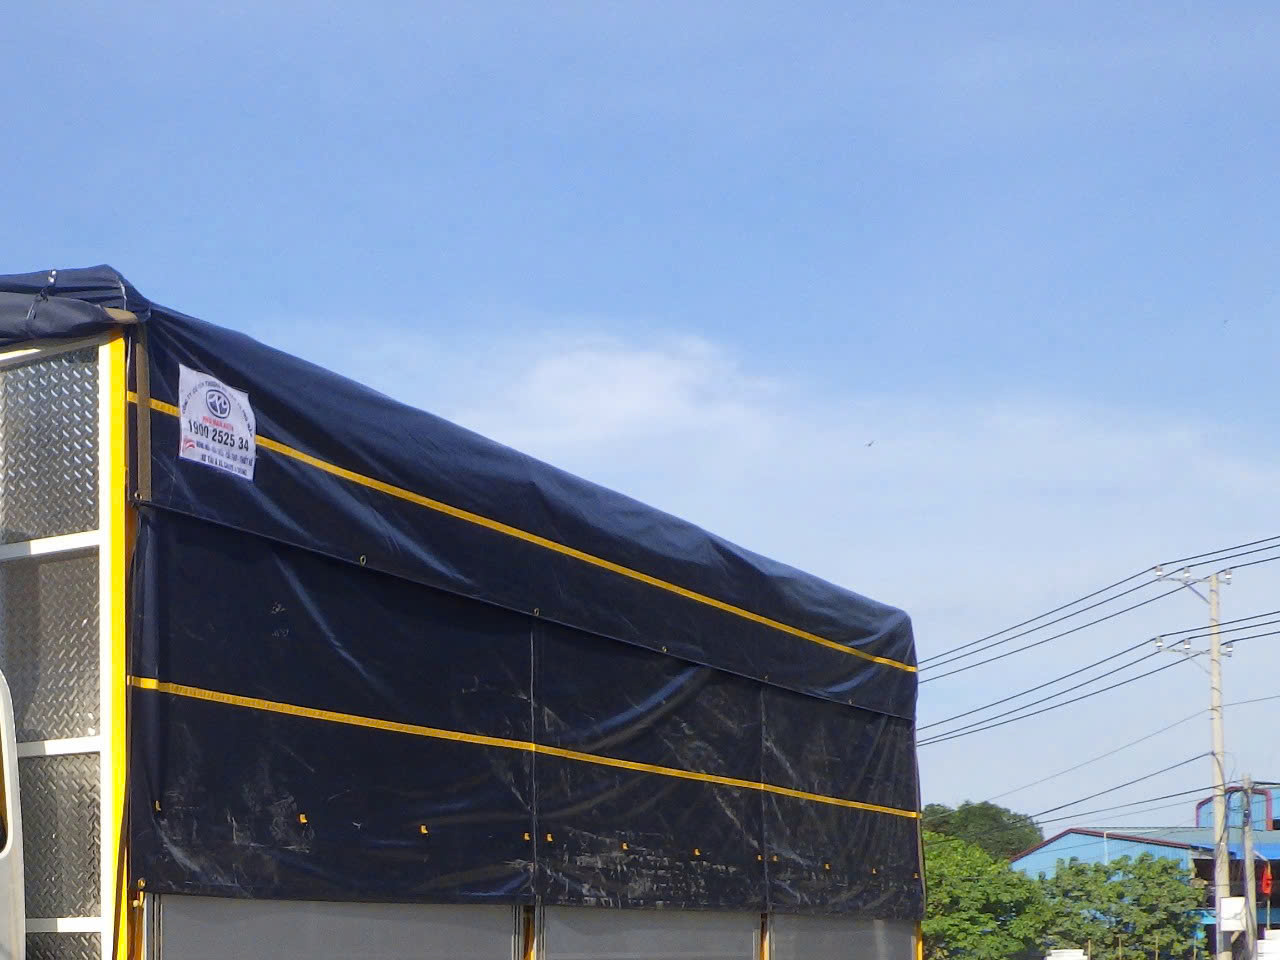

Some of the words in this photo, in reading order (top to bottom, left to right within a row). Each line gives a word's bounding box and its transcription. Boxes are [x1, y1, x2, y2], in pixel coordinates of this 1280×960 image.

[188, 420, 209, 439] 1900
[211, 428, 235, 448] 2525
[238, 437, 249, 452] 34
